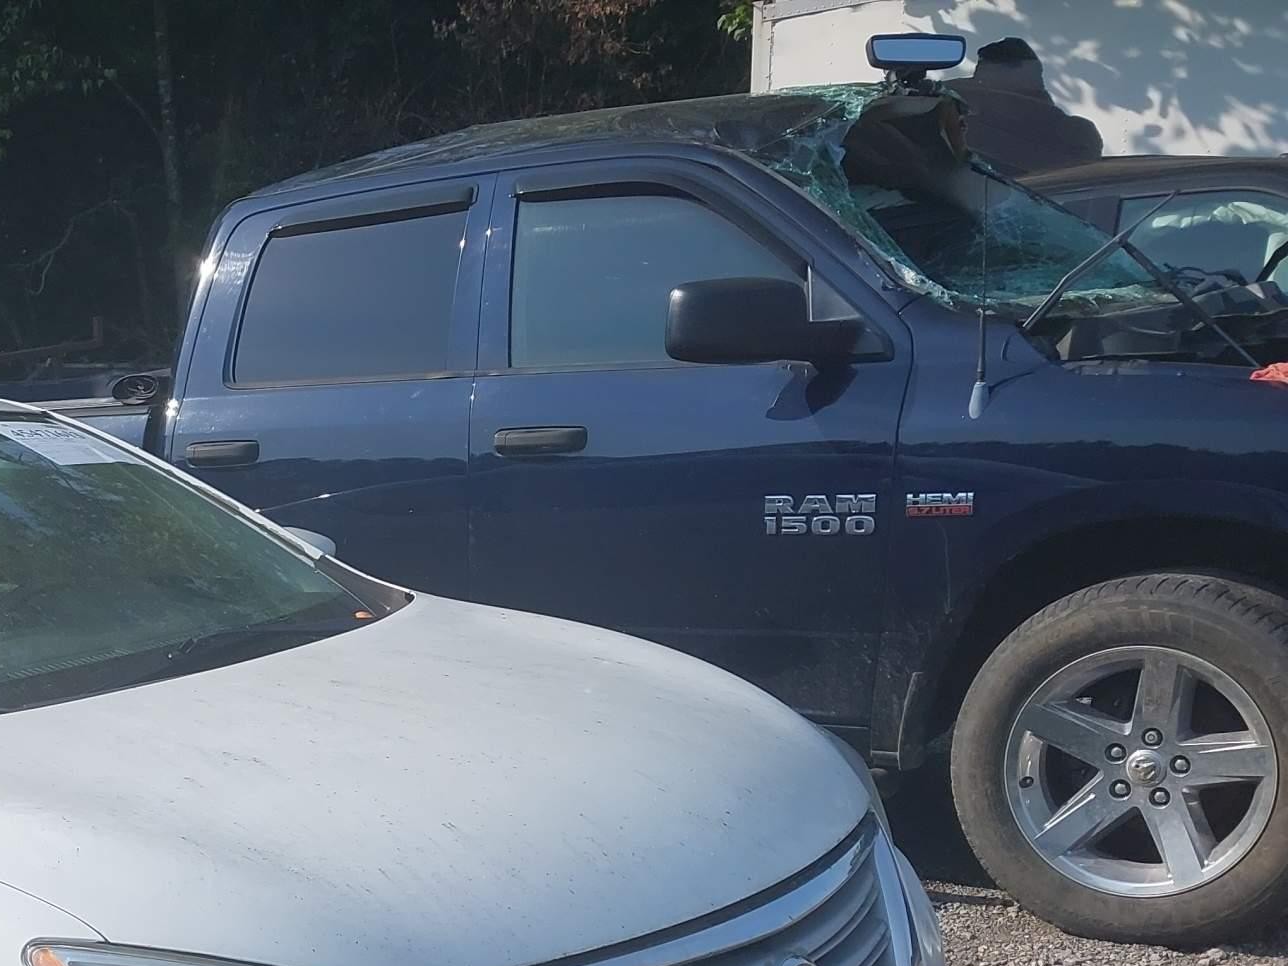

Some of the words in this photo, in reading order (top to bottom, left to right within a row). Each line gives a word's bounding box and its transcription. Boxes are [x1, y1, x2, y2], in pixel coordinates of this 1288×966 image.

[764, 494, 876, 513] RAM
[906, 492, 974, 505] HEMI
[764, 515, 876, 535] 1500
